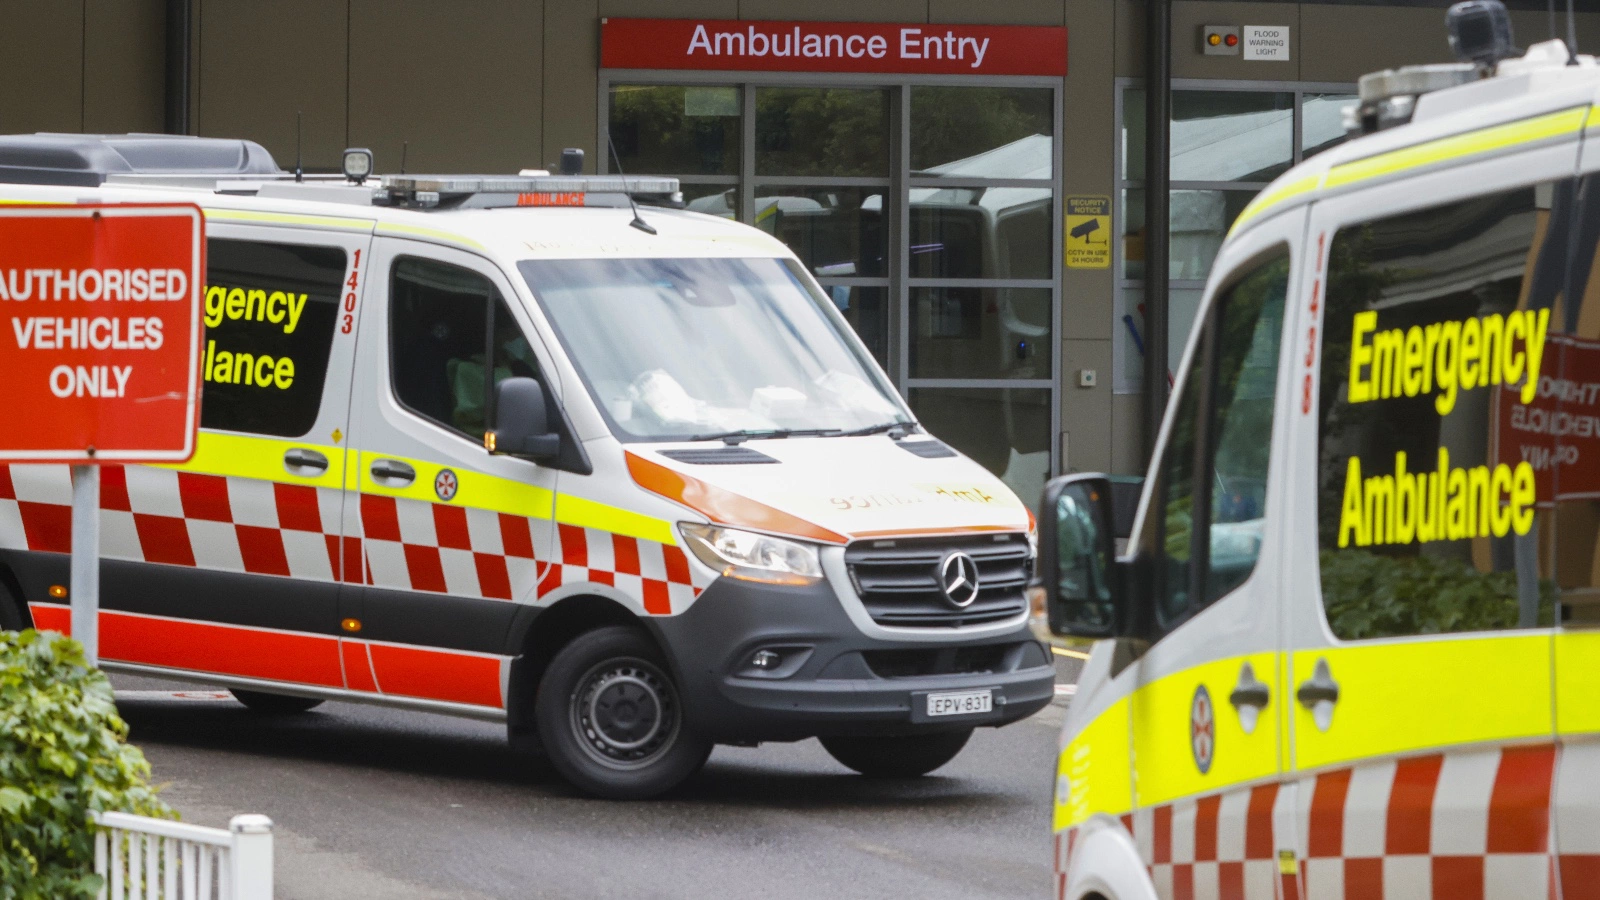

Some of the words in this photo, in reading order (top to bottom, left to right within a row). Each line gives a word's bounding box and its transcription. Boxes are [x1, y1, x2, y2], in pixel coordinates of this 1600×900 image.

[687, 24, 888, 59] Ambulance
[900, 28, 990, 68] Entry
[1249, 39, 1284, 47] WARNING
[1254, 30, 1279, 38] FLOOD
[1255, 48, 1277, 56] LIGHT
[517, 192, 585, 207] AMBULANCE
[1070, 199, 1106, 207] SECURITY
[1074, 206, 1102, 214] NOTICE
[341, 248, 361, 335] 1403
[203, 285, 308, 334] gency
[11, 316, 164, 350] VEHICLES
[202, 339, 295, 390] lance
[1348, 307, 1550, 416] Emergency
[50, 364, 133, 398] ONLY
[1338, 446, 1536, 548] Ambulance
